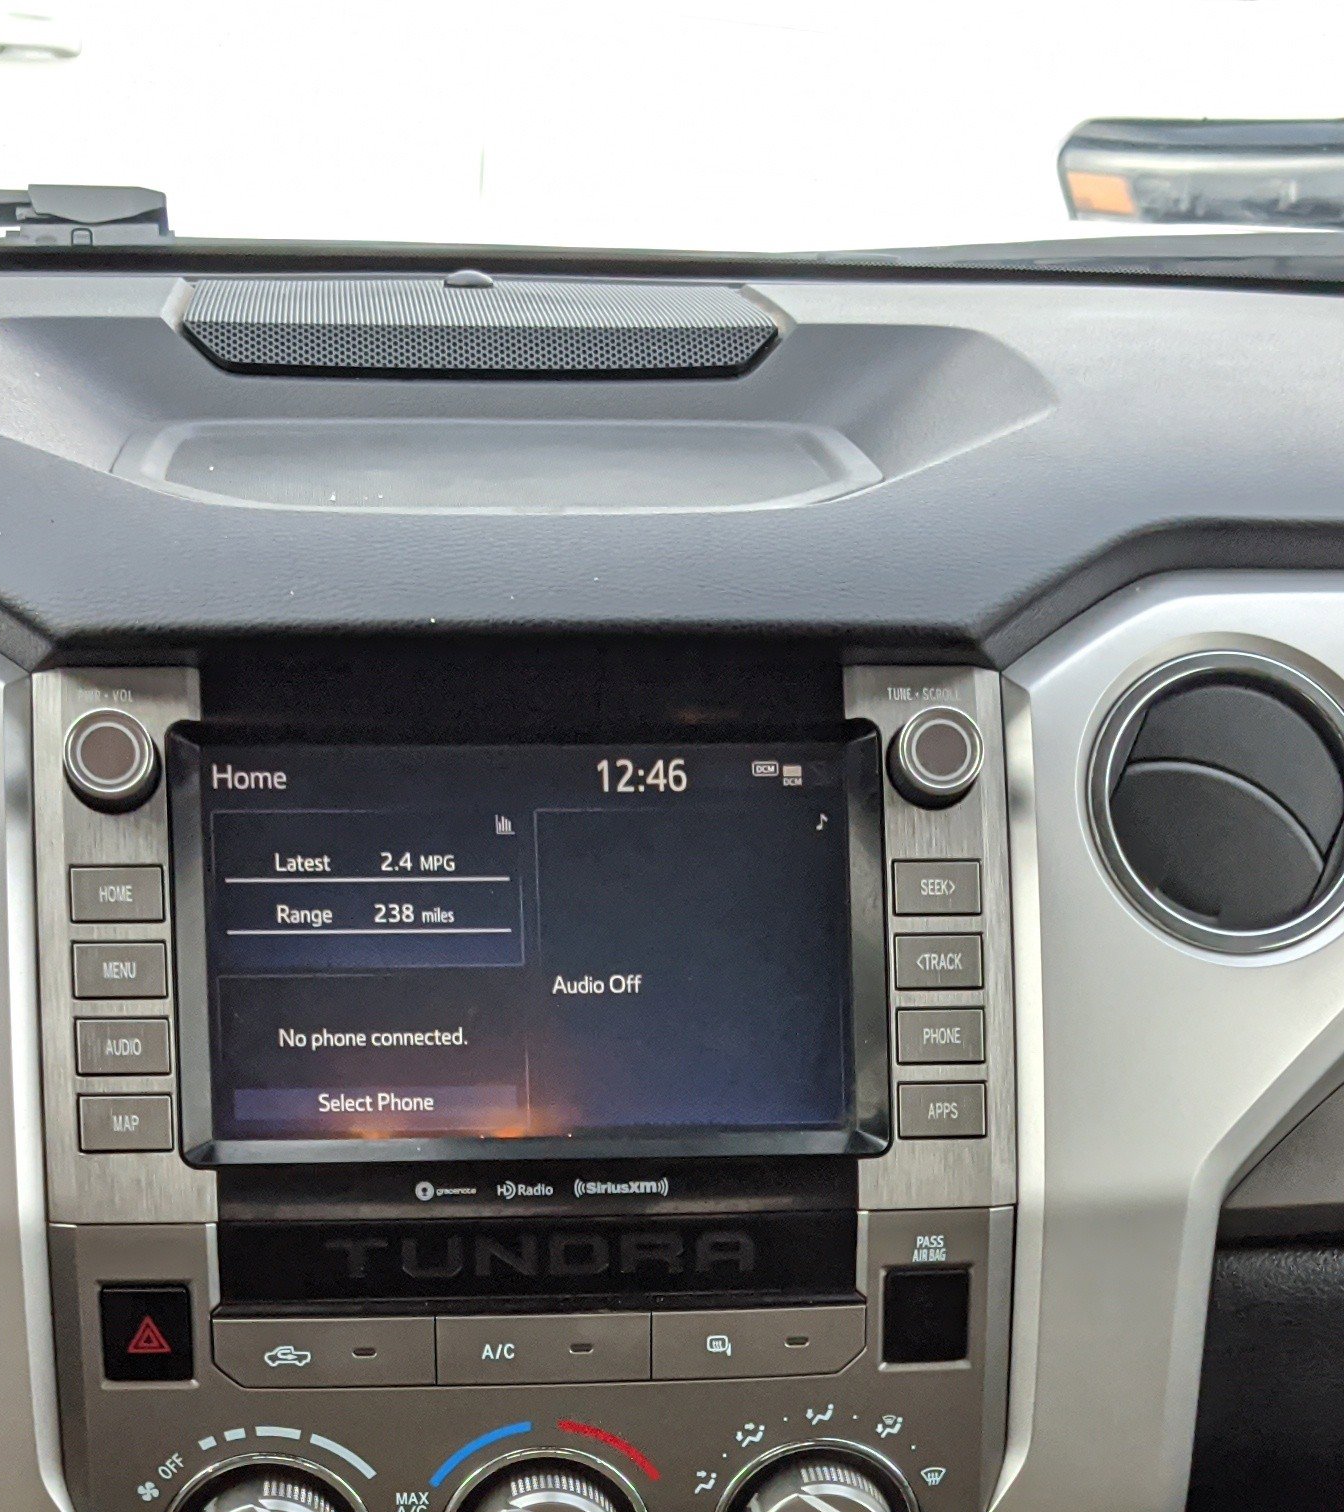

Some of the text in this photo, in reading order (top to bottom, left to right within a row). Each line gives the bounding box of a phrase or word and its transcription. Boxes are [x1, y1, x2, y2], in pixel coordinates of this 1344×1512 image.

[112, 689, 133, 703] VOL
[887, 687, 913, 701] TUNE
[212, 765, 288, 791] Home
[596, 759, 688, 794] 12:46
[274, 853, 456, 874] Latest 2.4 MPG
[99, 886, 134, 902] HOME
[276, 904, 455, 927] Range 238 miles
[103, 962, 137, 979] MENU
[552, 974, 642, 995] Audio Off
[278, 1028, 469, 1052] No phone connected.
[923, 1028, 962, 1045] PHONE
[105, 1038, 142, 1056] AUDIO
[318, 1093, 434, 1113] Select Phone
[927, 1103, 959, 1120] APPS
[112, 1115, 140, 1132] MAP
[518, 1183, 554, 1197] Radio
[916, 1235, 944, 1249] PASS
[325, 1231, 755, 1279] TUNDRA
[481, 1342, 515, 1361] A/C
[157, 1452, 185, 1480] OFF
[395, 1492, 429, 1505] MAX
